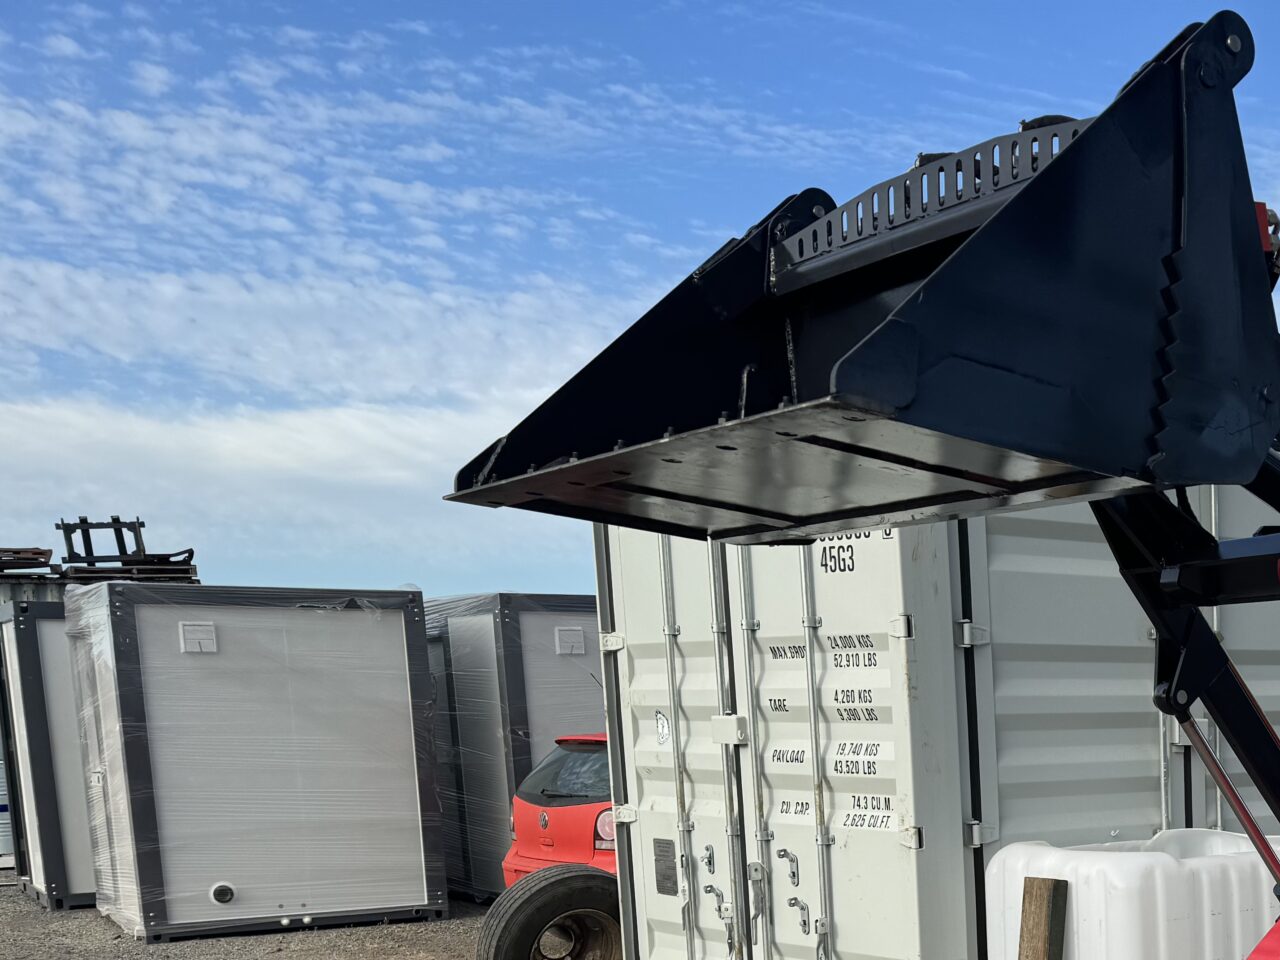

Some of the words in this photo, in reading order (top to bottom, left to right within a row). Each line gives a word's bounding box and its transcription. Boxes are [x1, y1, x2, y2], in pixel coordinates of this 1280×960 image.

[820, 544, 855, 573] 45G3
[856, 634, 874, 648] KGS
[863, 652, 878, 667] LBS
[768, 699, 790, 712] TARE
[858, 689, 873, 704] KGS
[860, 708, 879, 721] LBS
[772, 749, 805, 763] PAYLOAD
[863, 743, 880, 757] KGS
[862, 760, 877, 775] LBS
[851, 795, 868, 810] 74.3
